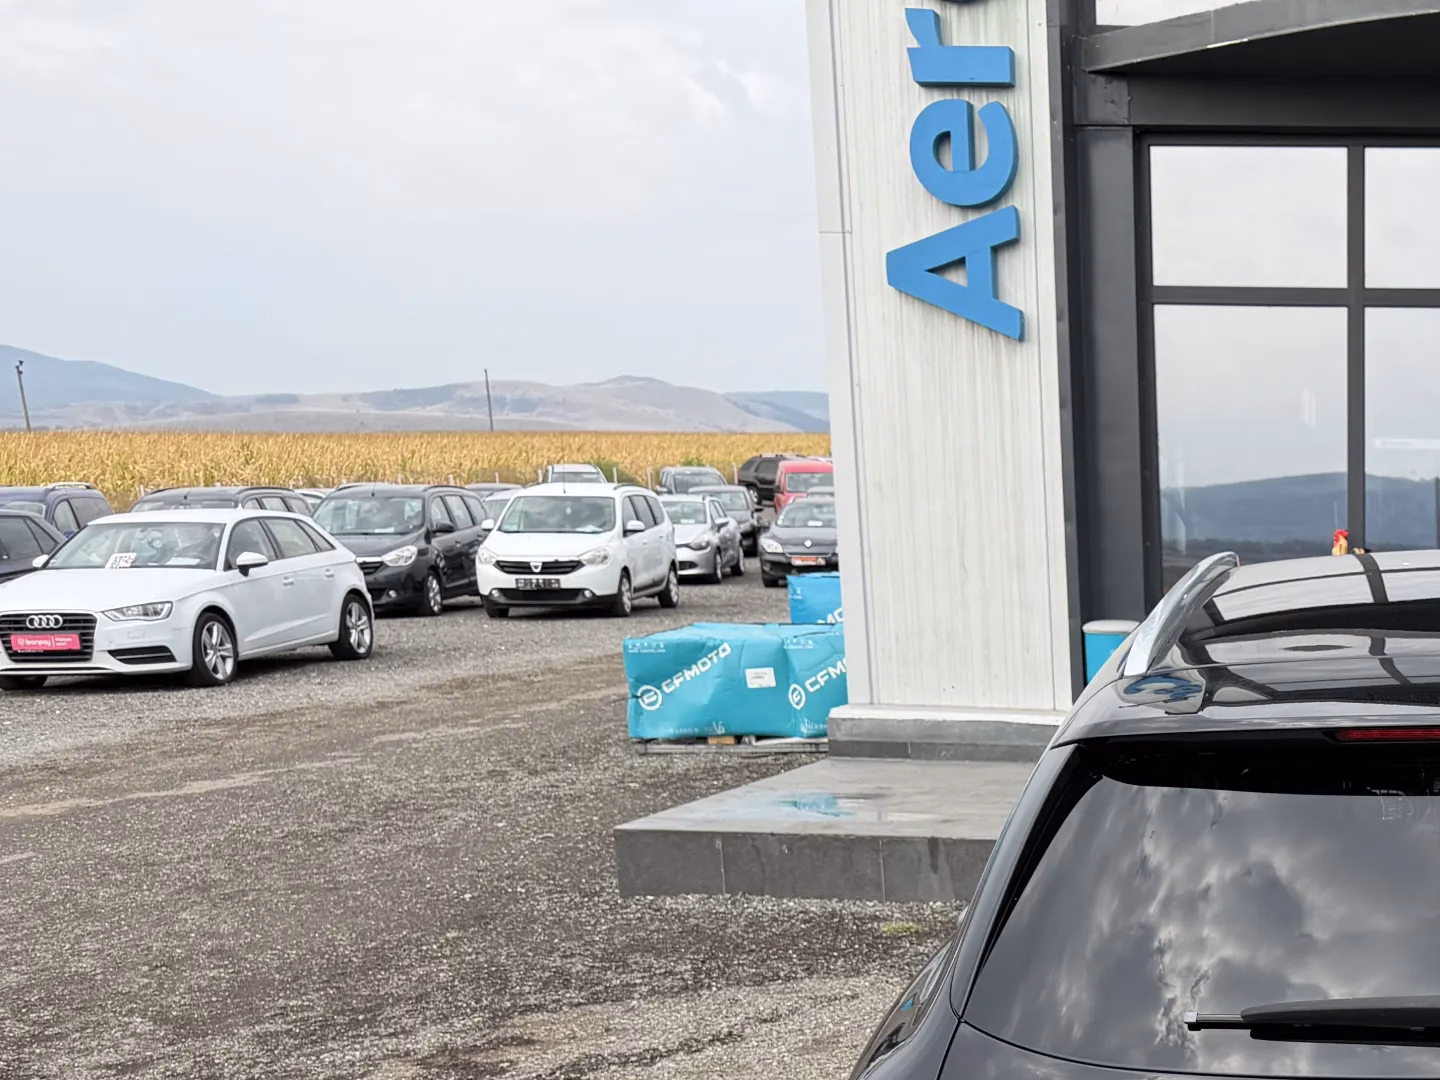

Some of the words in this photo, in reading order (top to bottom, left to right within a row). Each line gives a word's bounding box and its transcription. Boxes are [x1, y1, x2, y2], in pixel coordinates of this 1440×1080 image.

[886, 0, 1025, 342] Aer
[661, 642, 731, 694] CFMOTO
[804, 657, 847, 692] CFM
